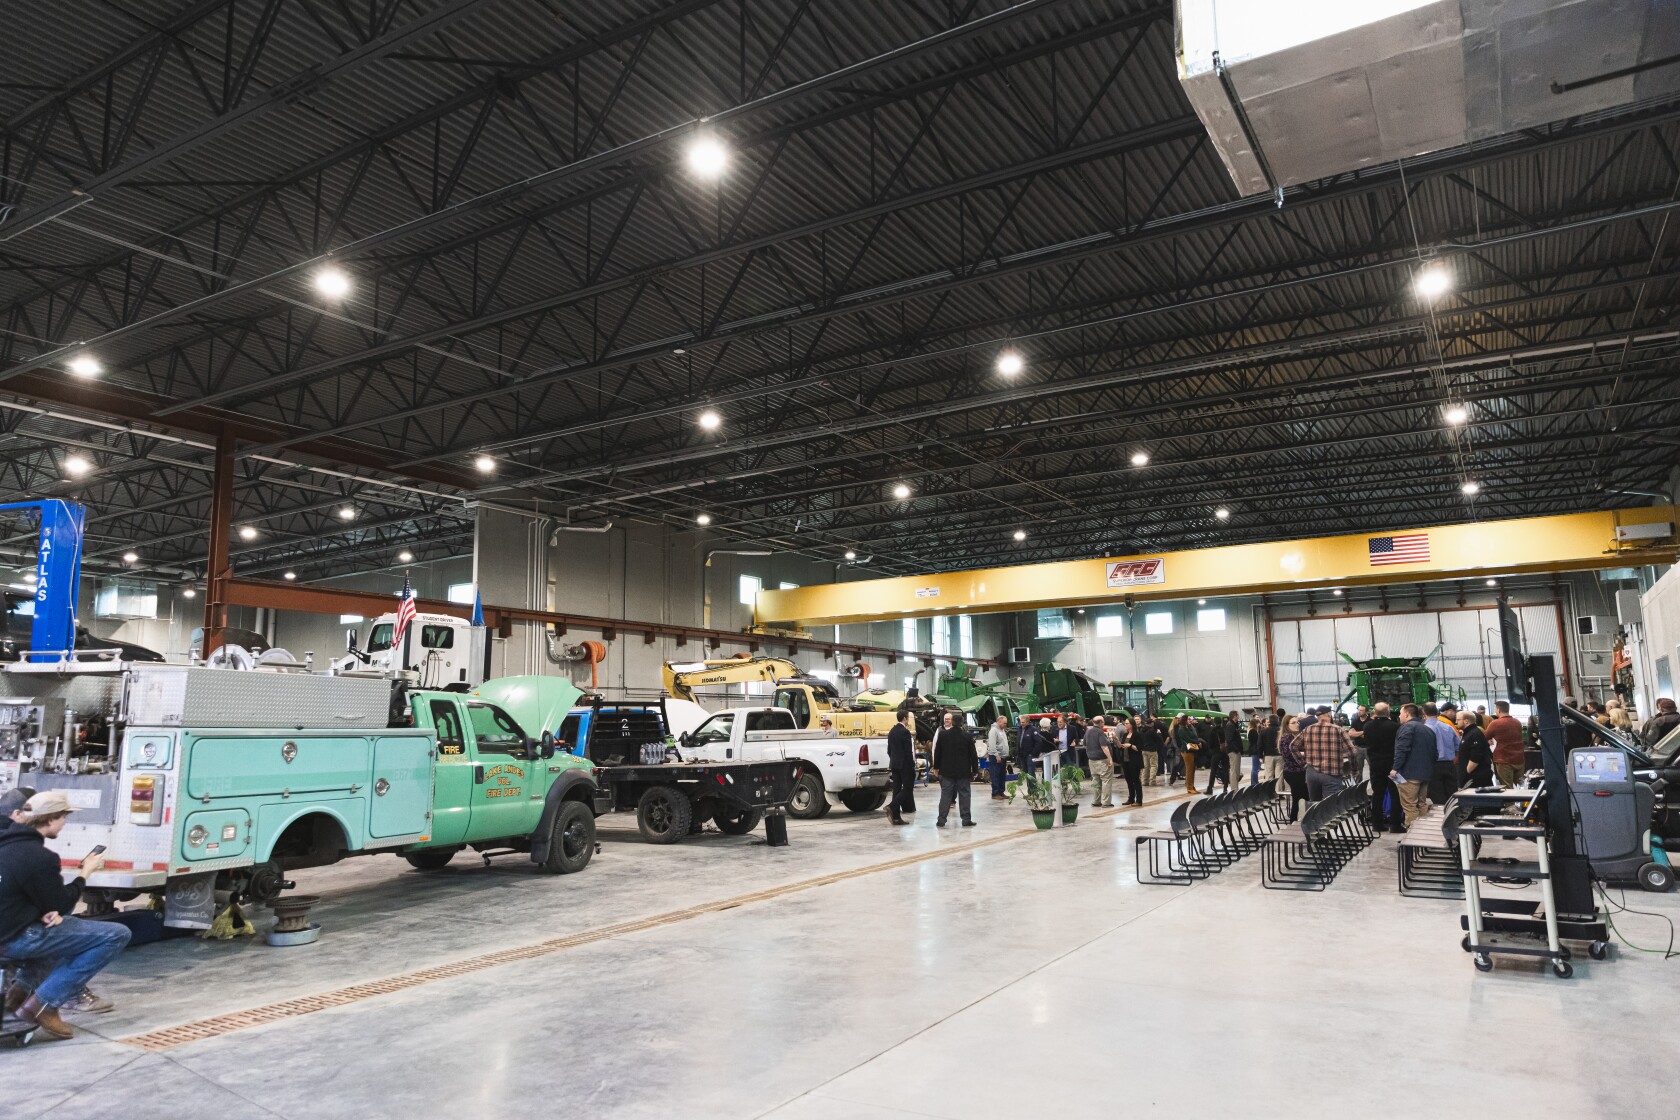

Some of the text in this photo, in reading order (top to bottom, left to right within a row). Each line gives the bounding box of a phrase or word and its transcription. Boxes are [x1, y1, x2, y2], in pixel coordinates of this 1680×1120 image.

[37, 538, 51, 602] ATLAS
[701, 675, 727, 684] KOMATSU
[621, 718, 629, 729] 2
[443, 745, 461, 755] FIRE
[484, 764, 525, 783] LAKE ANDES
[497, 776, 512, 786] VOL.
[486, 788, 502, 799] FIRE
